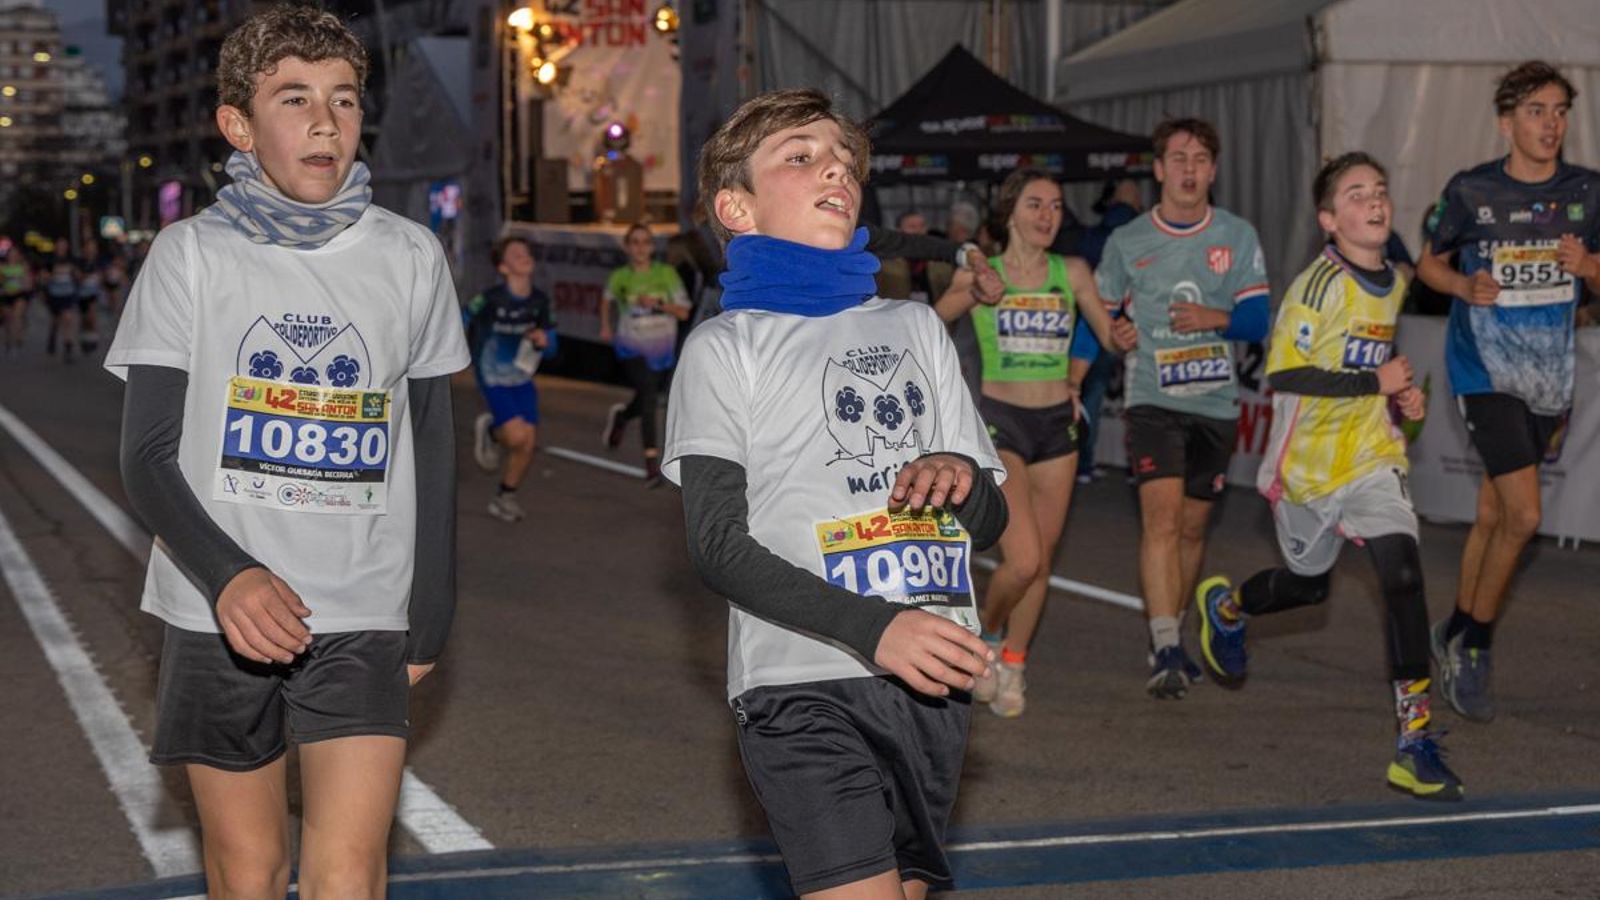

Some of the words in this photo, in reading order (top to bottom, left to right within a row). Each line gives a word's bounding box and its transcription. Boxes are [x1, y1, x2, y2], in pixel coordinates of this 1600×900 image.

[283, 313, 331, 325] CLUB
[274, 323, 338, 348] POLIDEPORTIVO
[842, 353, 900, 375] POLIDEPORTIVO
[846, 345, 891, 358] CLUB
[1347, 339, 1390, 366] 110
[1161, 359, 1232, 384] 11922
[265, 387, 297, 411] 42
[230, 415, 387, 465] 10830
[855, 515, 892, 541] 42
[831, 545, 963, 596] 10987
